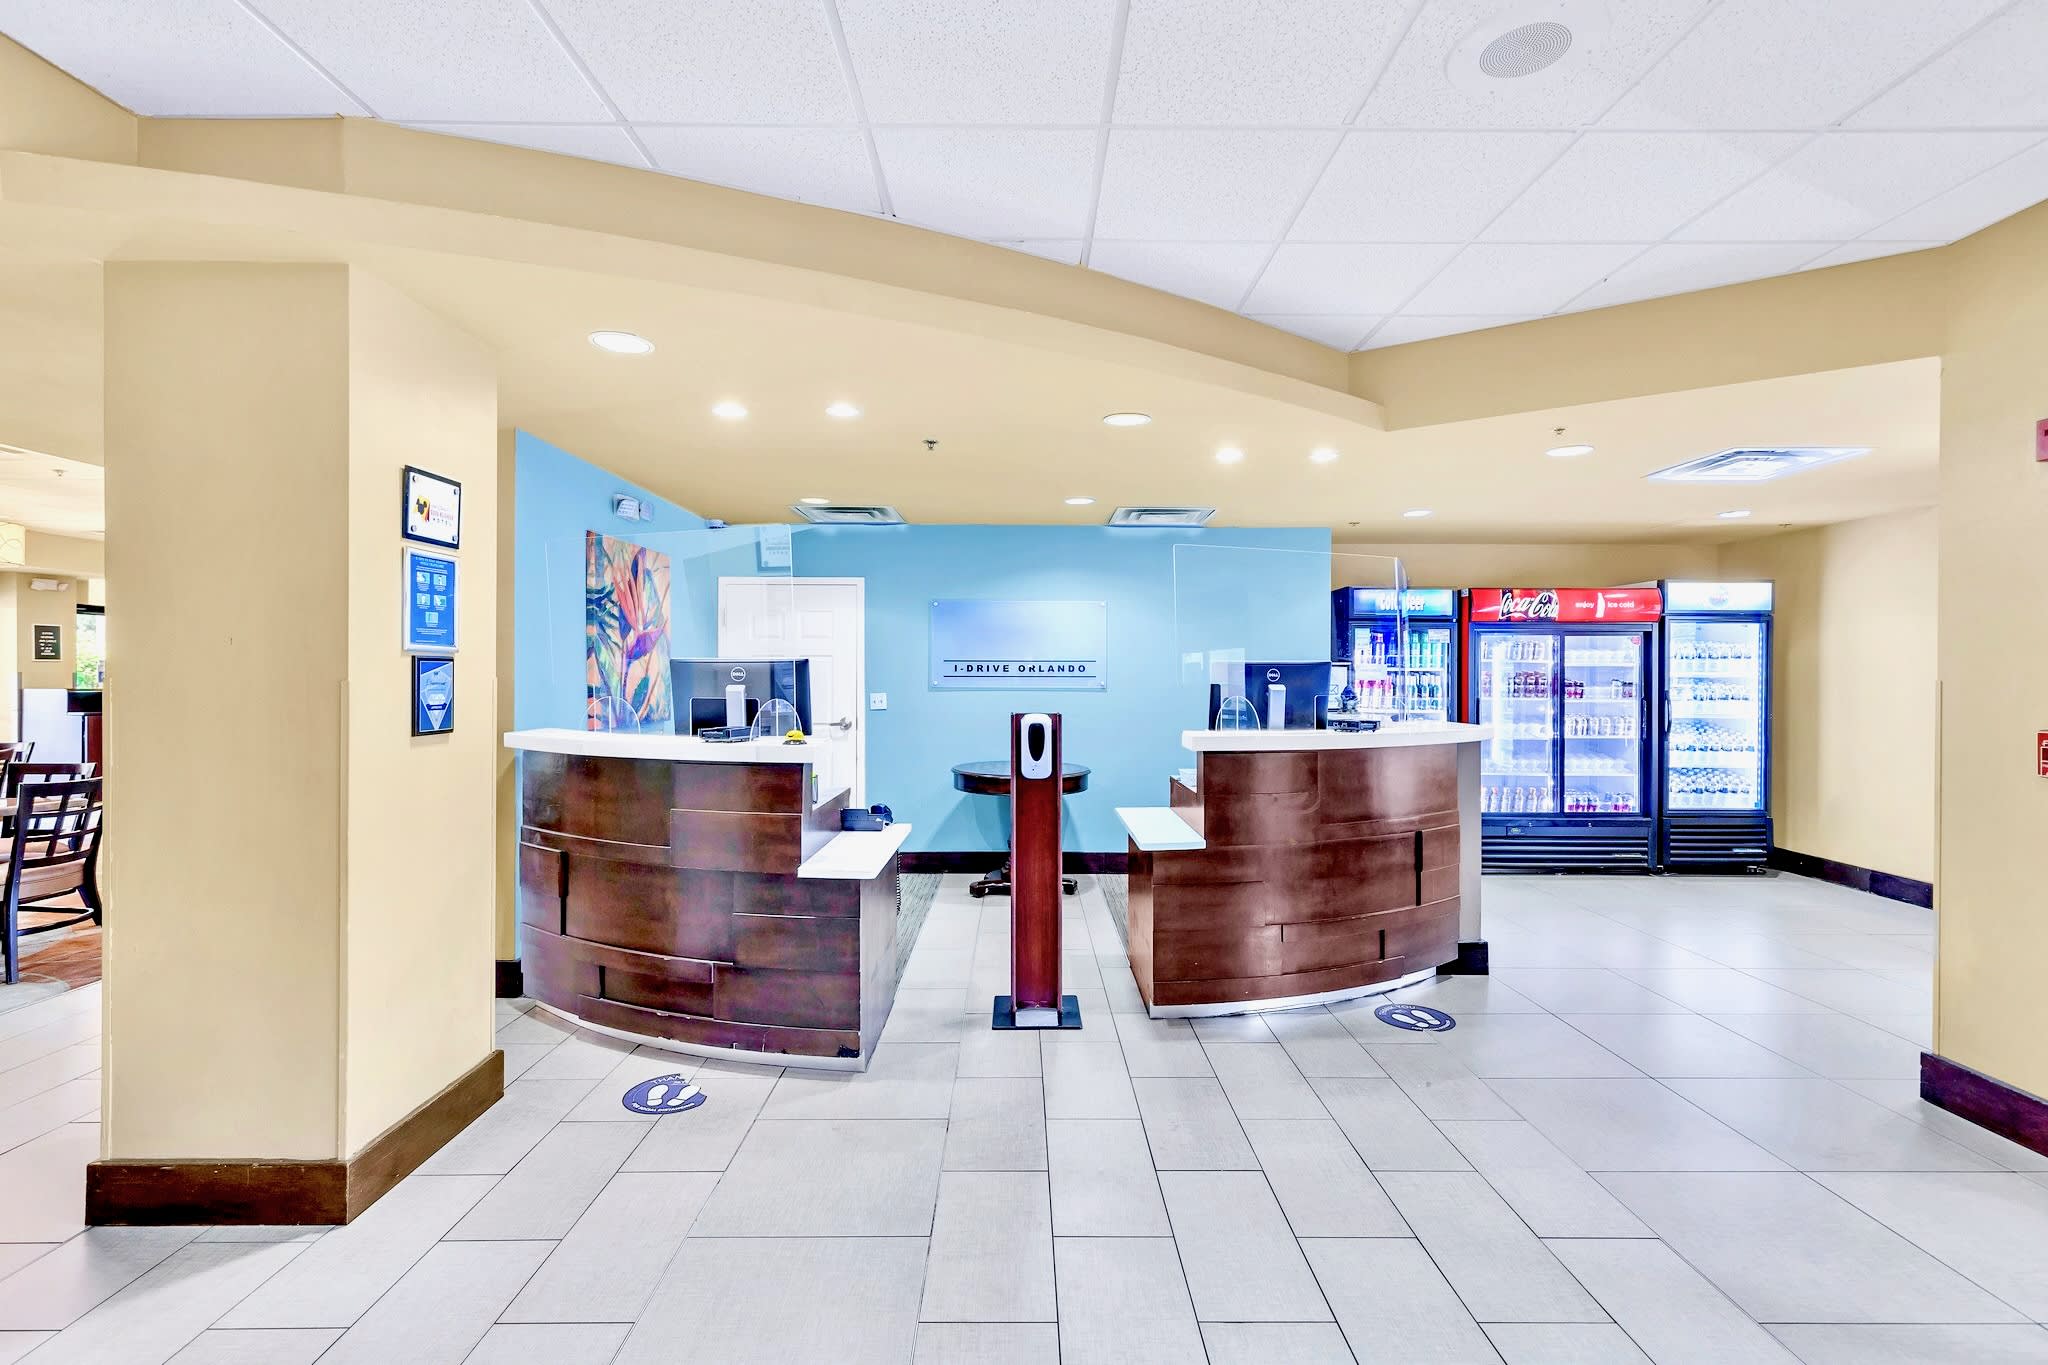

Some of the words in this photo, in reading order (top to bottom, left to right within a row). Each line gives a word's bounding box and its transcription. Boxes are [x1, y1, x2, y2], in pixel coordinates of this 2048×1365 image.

[1575, 600, 1595, 609] enjoy
[1618, 600, 1635, 609] cold
[954, 664, 1010, 672] I-DRIVE
[1017, 664, 1087, 673] ORLANDO
